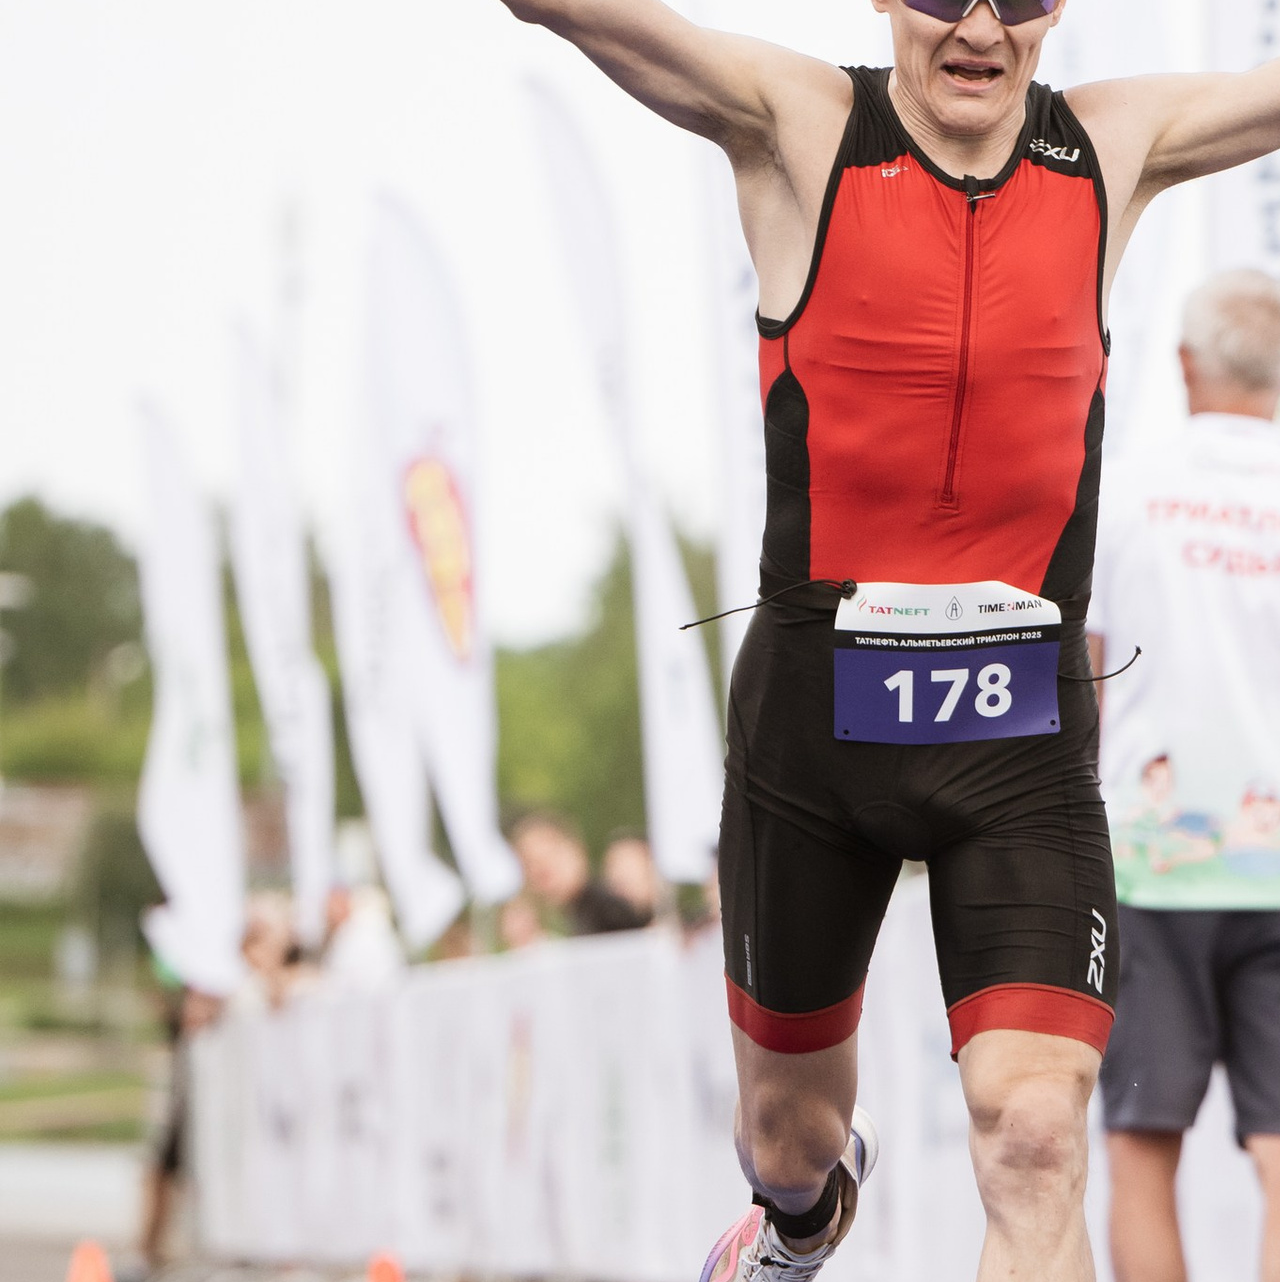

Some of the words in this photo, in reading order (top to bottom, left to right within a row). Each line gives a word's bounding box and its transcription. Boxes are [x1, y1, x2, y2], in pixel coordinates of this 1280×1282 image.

[868, 605, 930, 617] TATNEFT
[855, 636, 899, 648] ТАТНЕФТЬ
[899, 636, 975, 648] АЛЬМЕТЬЕВСКИЙ
[976, 633, 1019, 645] ТРИАТЛОН
[1021, 631, 1042, 640] 2025
[883, 663, 1012, 723] 178
[1086, 907, 1107, 995] 2XU
